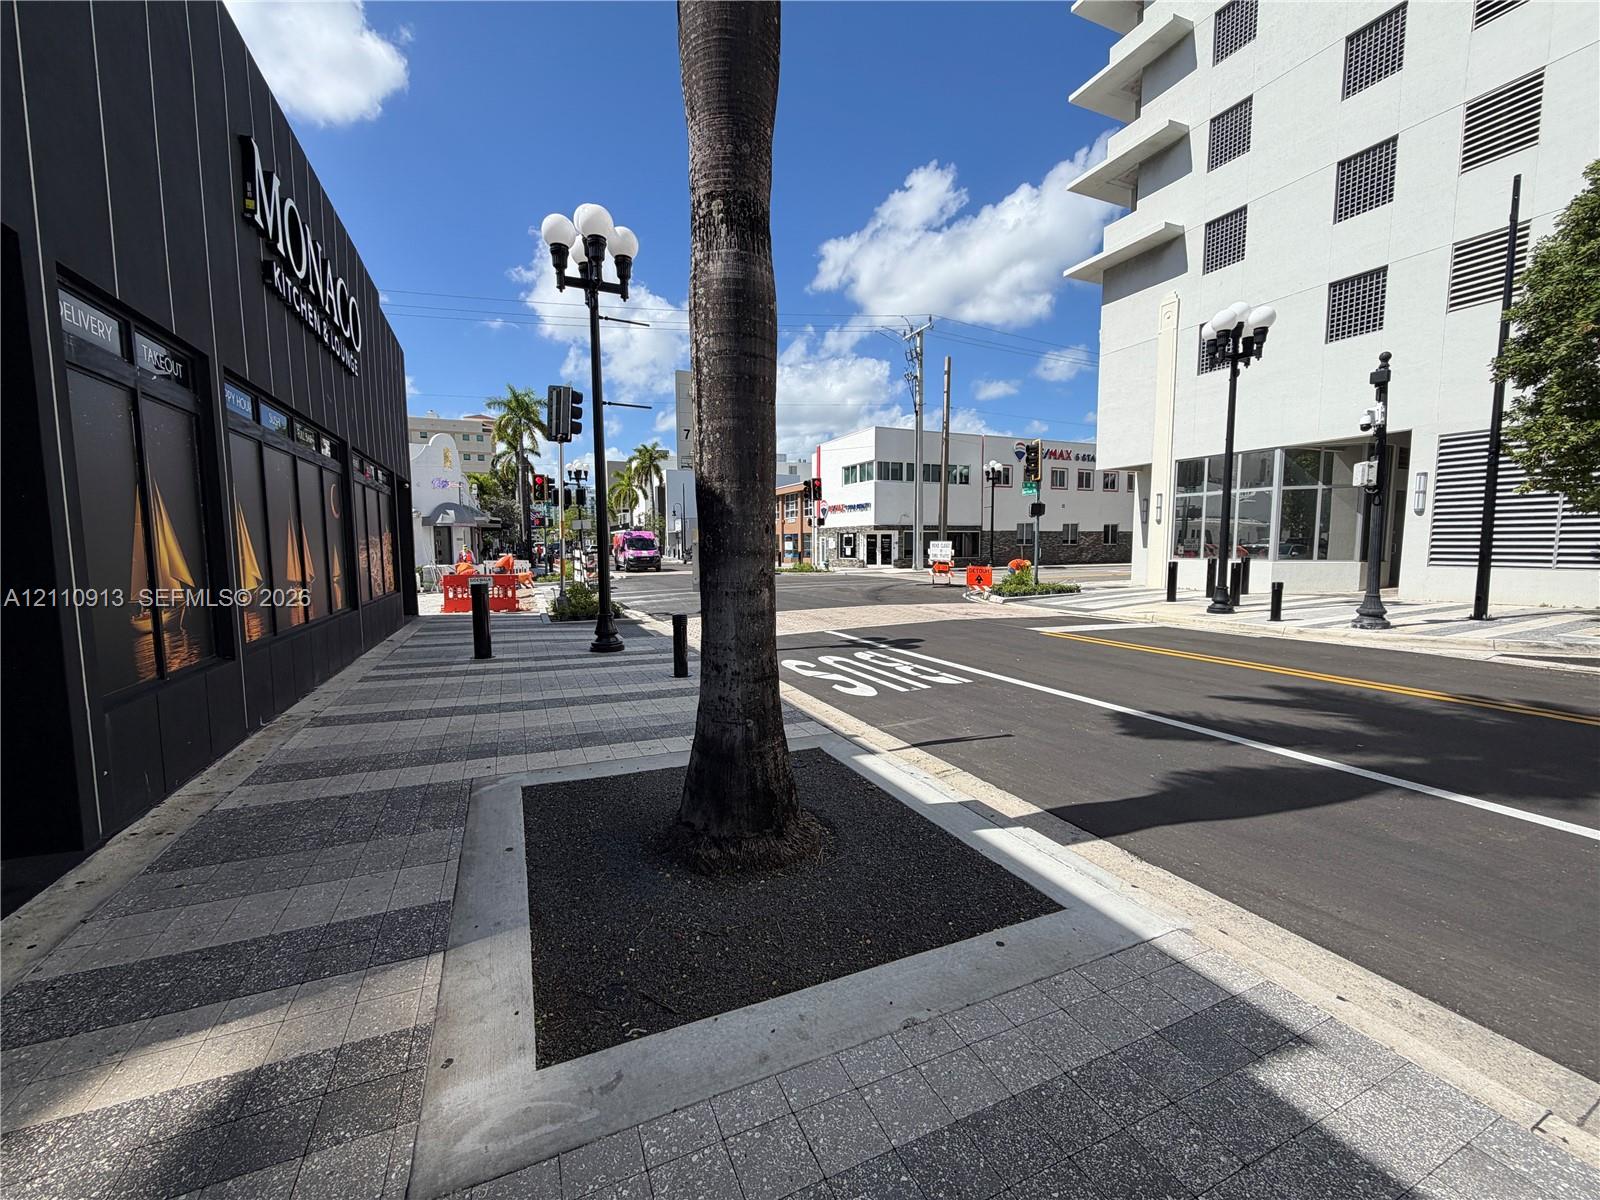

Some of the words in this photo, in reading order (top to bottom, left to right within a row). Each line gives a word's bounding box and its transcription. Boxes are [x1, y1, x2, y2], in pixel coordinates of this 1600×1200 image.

[251, 137, 361, 352] MONACO
[273, 261, 321, 336] KITCHEN
[322, 320, 330, 342] &
[330, 335, 359, 377] LOUNGE
[142, 344, 183, 379] TAKEOUT
[683, 429, 691, 440] 7
[1040, 448, 1072, 461] /MAX
